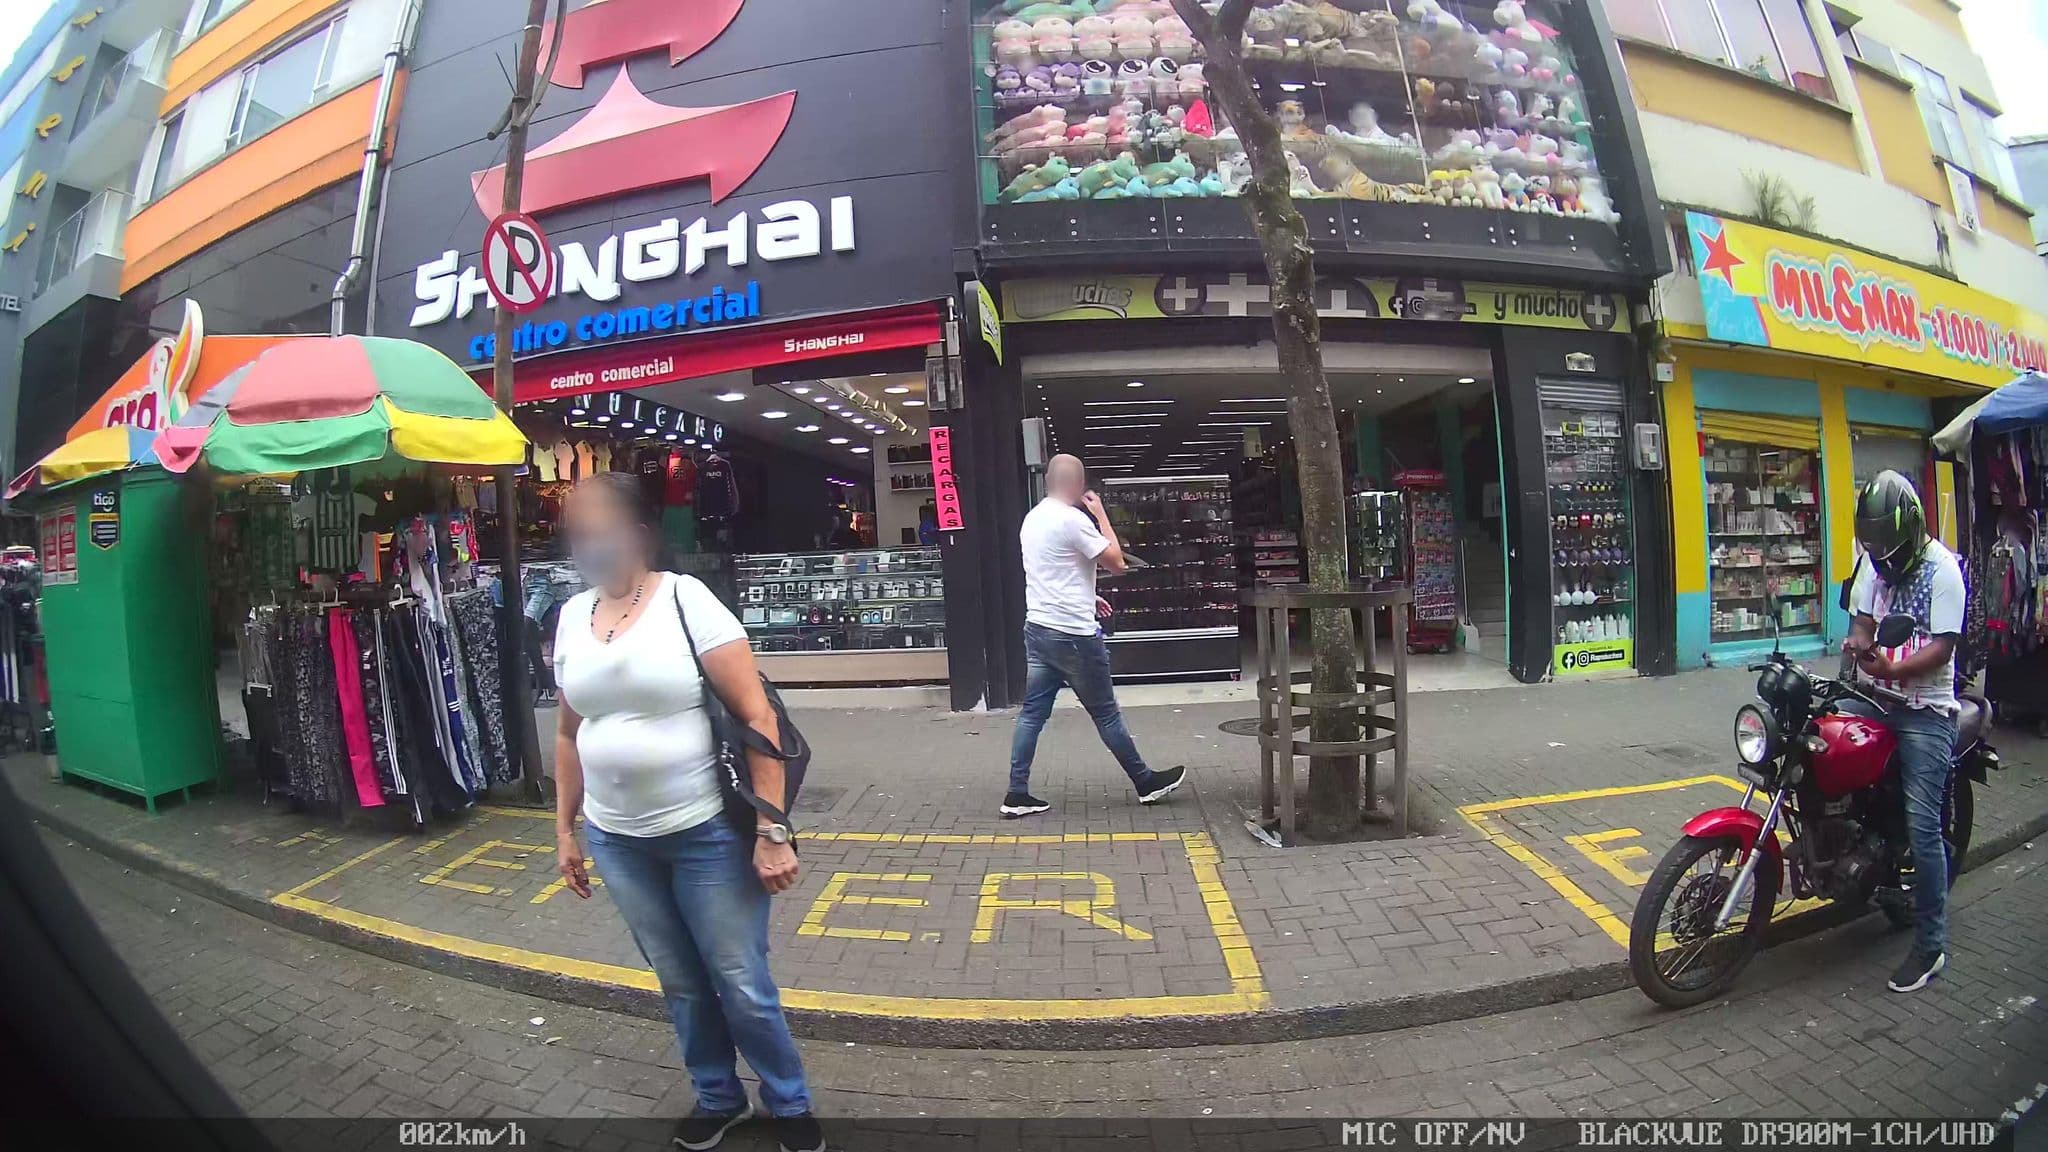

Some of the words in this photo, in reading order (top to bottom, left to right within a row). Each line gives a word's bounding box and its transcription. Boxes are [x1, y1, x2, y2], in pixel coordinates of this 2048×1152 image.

[575, 280, 760, 342] comercial
[1494, 291, 1507, 321] y
[1513, 287, 1579, 319] mucho
[1772, 261, 1921, 343] MIL&MAX
[550, 369, 594, 390] centro
[600, 356, 674, 383] comercial
[934, 430, 959, 528] RECARGAS
